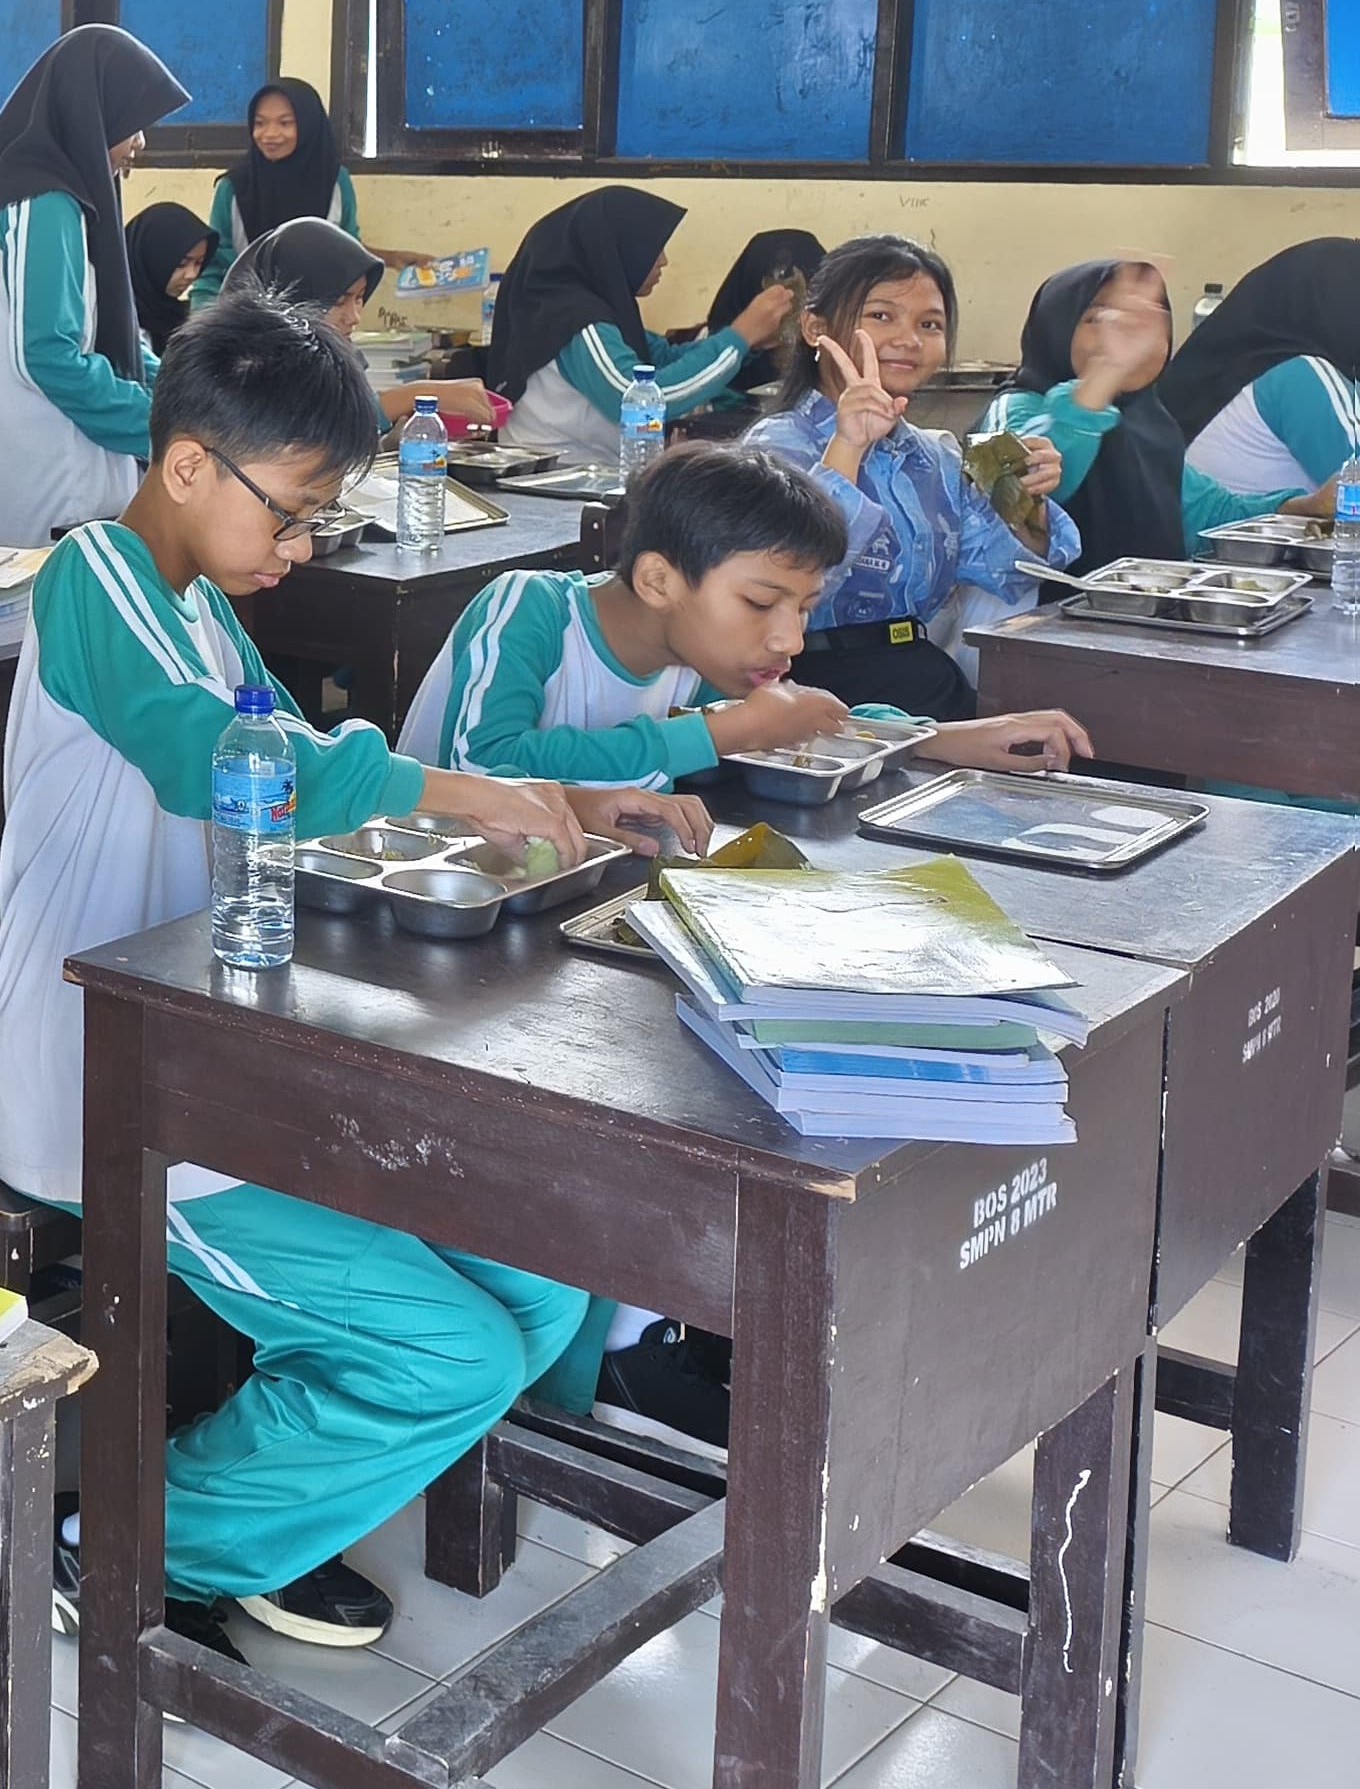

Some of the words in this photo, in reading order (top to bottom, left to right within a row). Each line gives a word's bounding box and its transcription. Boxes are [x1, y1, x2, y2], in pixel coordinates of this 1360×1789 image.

[959, 1215, 1006, 1270] SMPN
[1010, 1207, 1021, 1236] 8
[1023, 1181, 1058, 1229] MTR
[973, 1184, 1008, 1229] BOS
[1010, 1157, 1048, 1204] 2023
